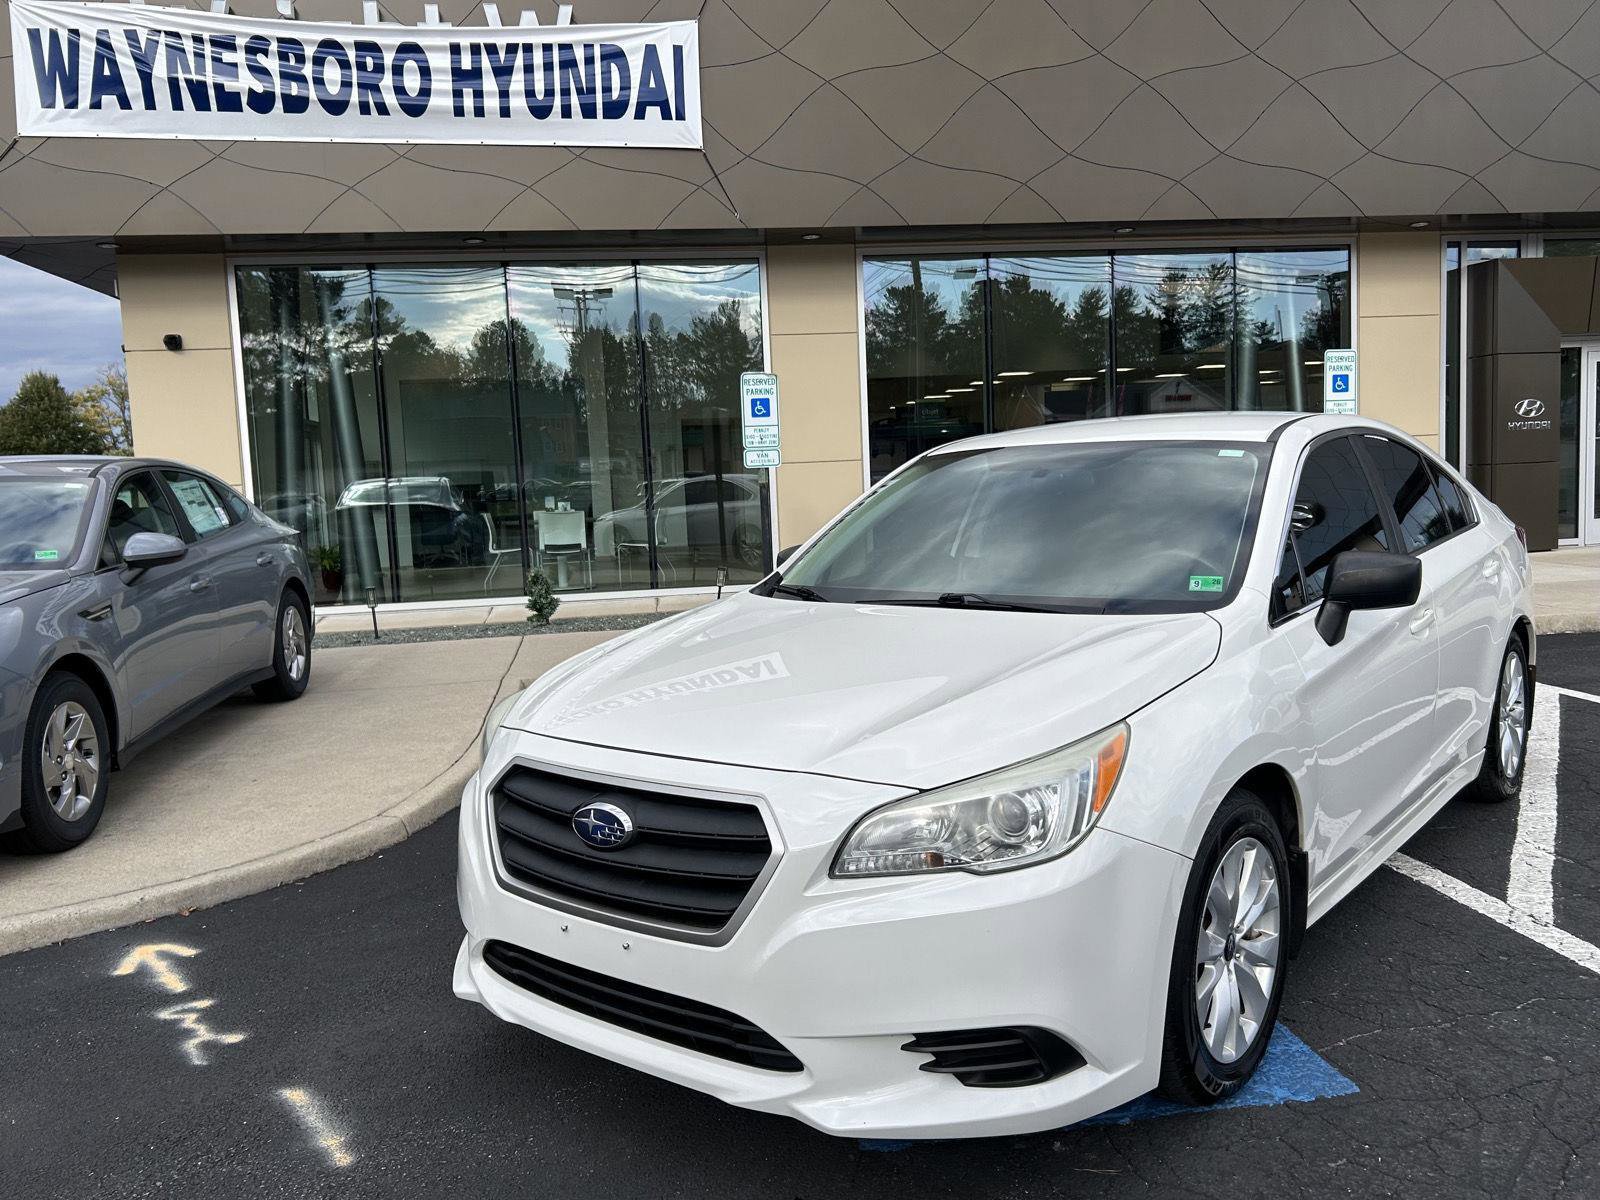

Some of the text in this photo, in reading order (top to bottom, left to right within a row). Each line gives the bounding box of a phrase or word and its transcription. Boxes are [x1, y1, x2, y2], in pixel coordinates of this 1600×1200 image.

[27, 28, 686, 120] WAYNESBORO HYUNDAI
[744, 378, 775, 386] RESERVED
[746, 388, 774, 396] PARKING
[1508, 420, 1551, 430] HYUNDAI
